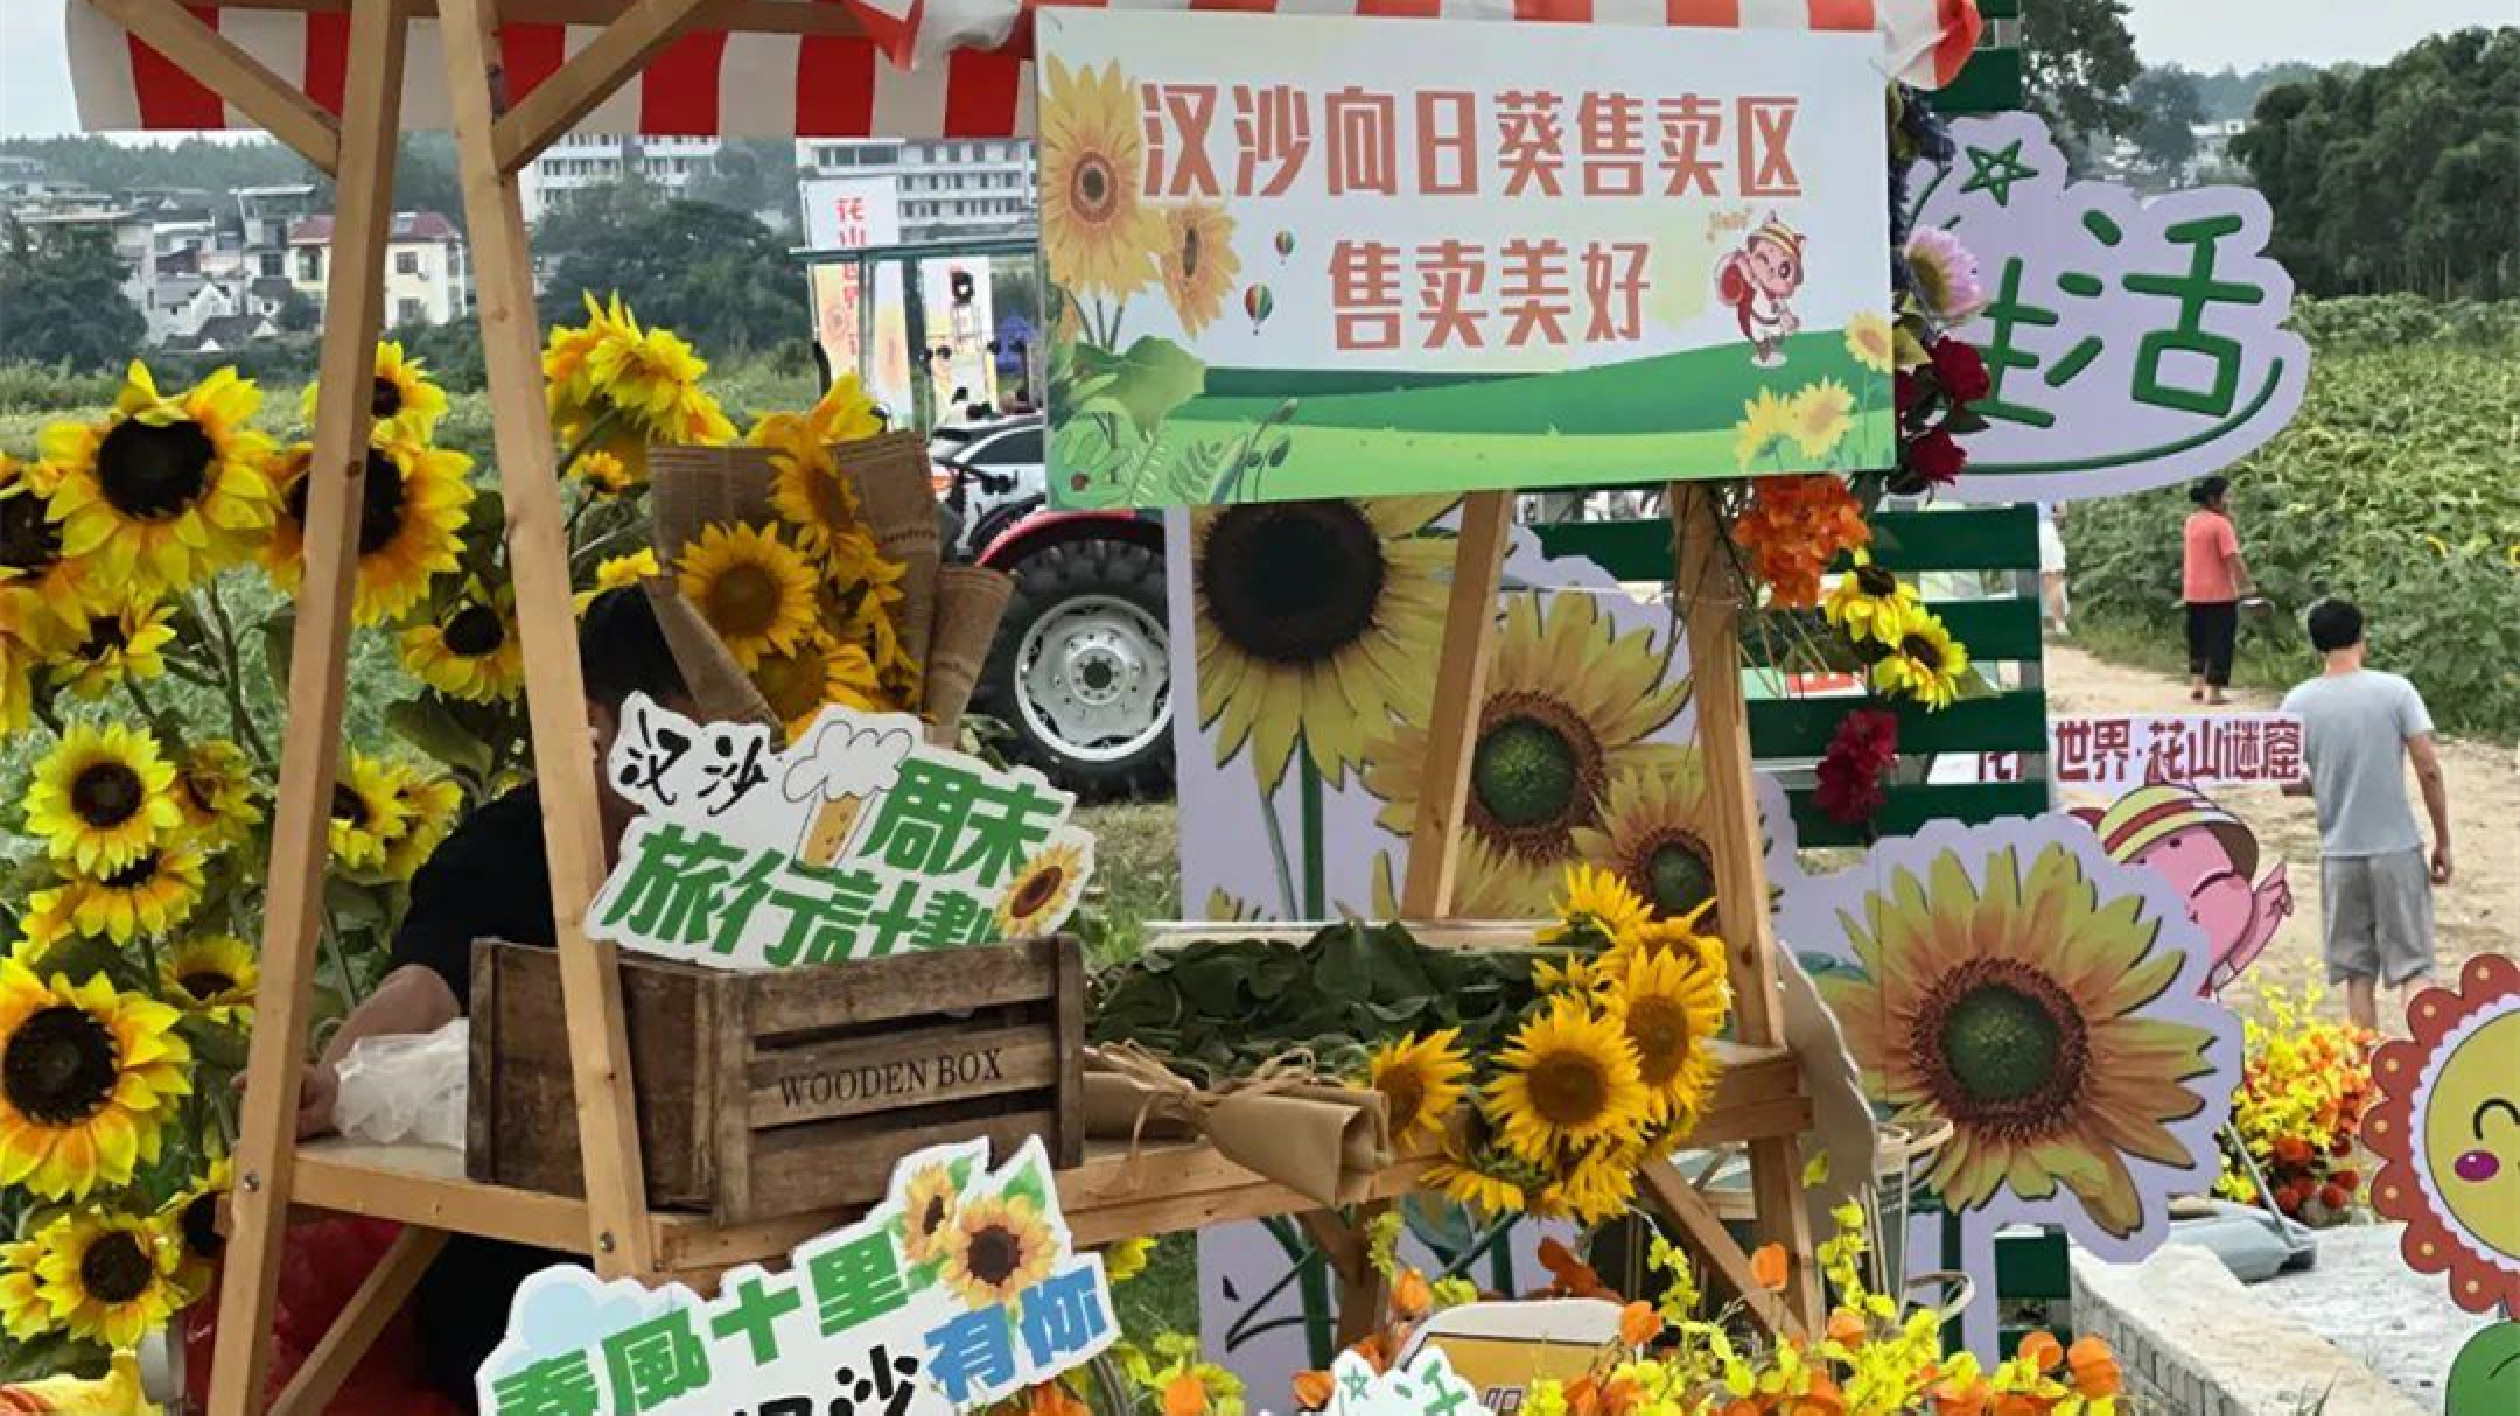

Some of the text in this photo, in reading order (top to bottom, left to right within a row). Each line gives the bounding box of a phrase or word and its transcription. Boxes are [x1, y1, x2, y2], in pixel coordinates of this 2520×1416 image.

[1141, 84, 1802, 198] 汉沙向日葵售卖区
[1329, 239, 1651, 351] 售卖美好
[1962, 211, 2264, 429] 生活
[619, 708, 768, 816] 汉沙
[1978, 719, 2302, 783] 世界·花山谜窟
[860, 757, 1063, 888] 周末
[779, 1048, 1002, 1107] WOODEN BOX
[924, 1265, 1107, 1402] 有你
